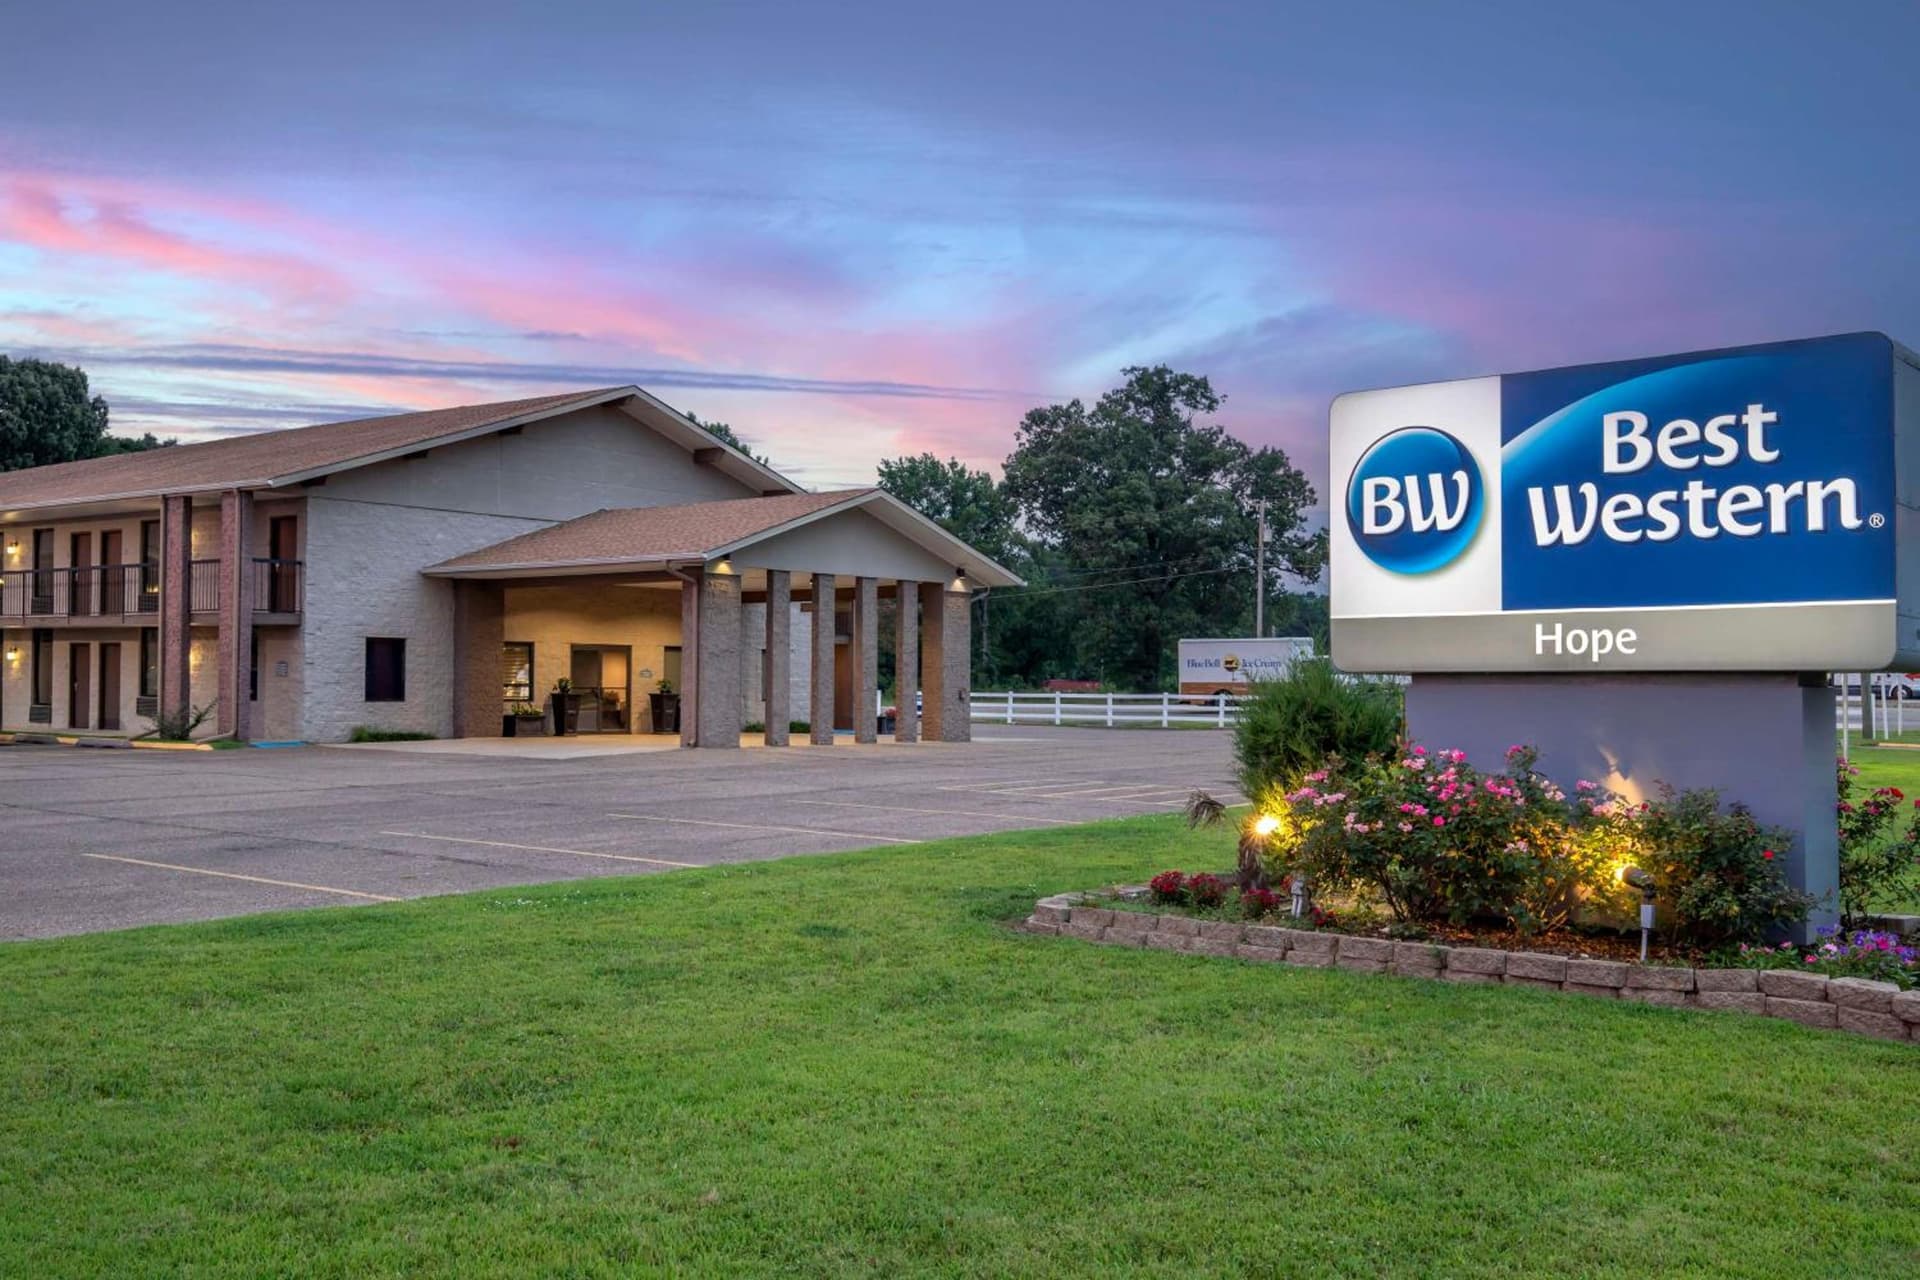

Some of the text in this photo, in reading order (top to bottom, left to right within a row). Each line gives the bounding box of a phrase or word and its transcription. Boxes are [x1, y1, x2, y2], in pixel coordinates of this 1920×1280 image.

[1603, 404, 1780, 473] Best
[1363, 470, 1470, 534] BW
[1535, 622, 1638, 662] Hope
